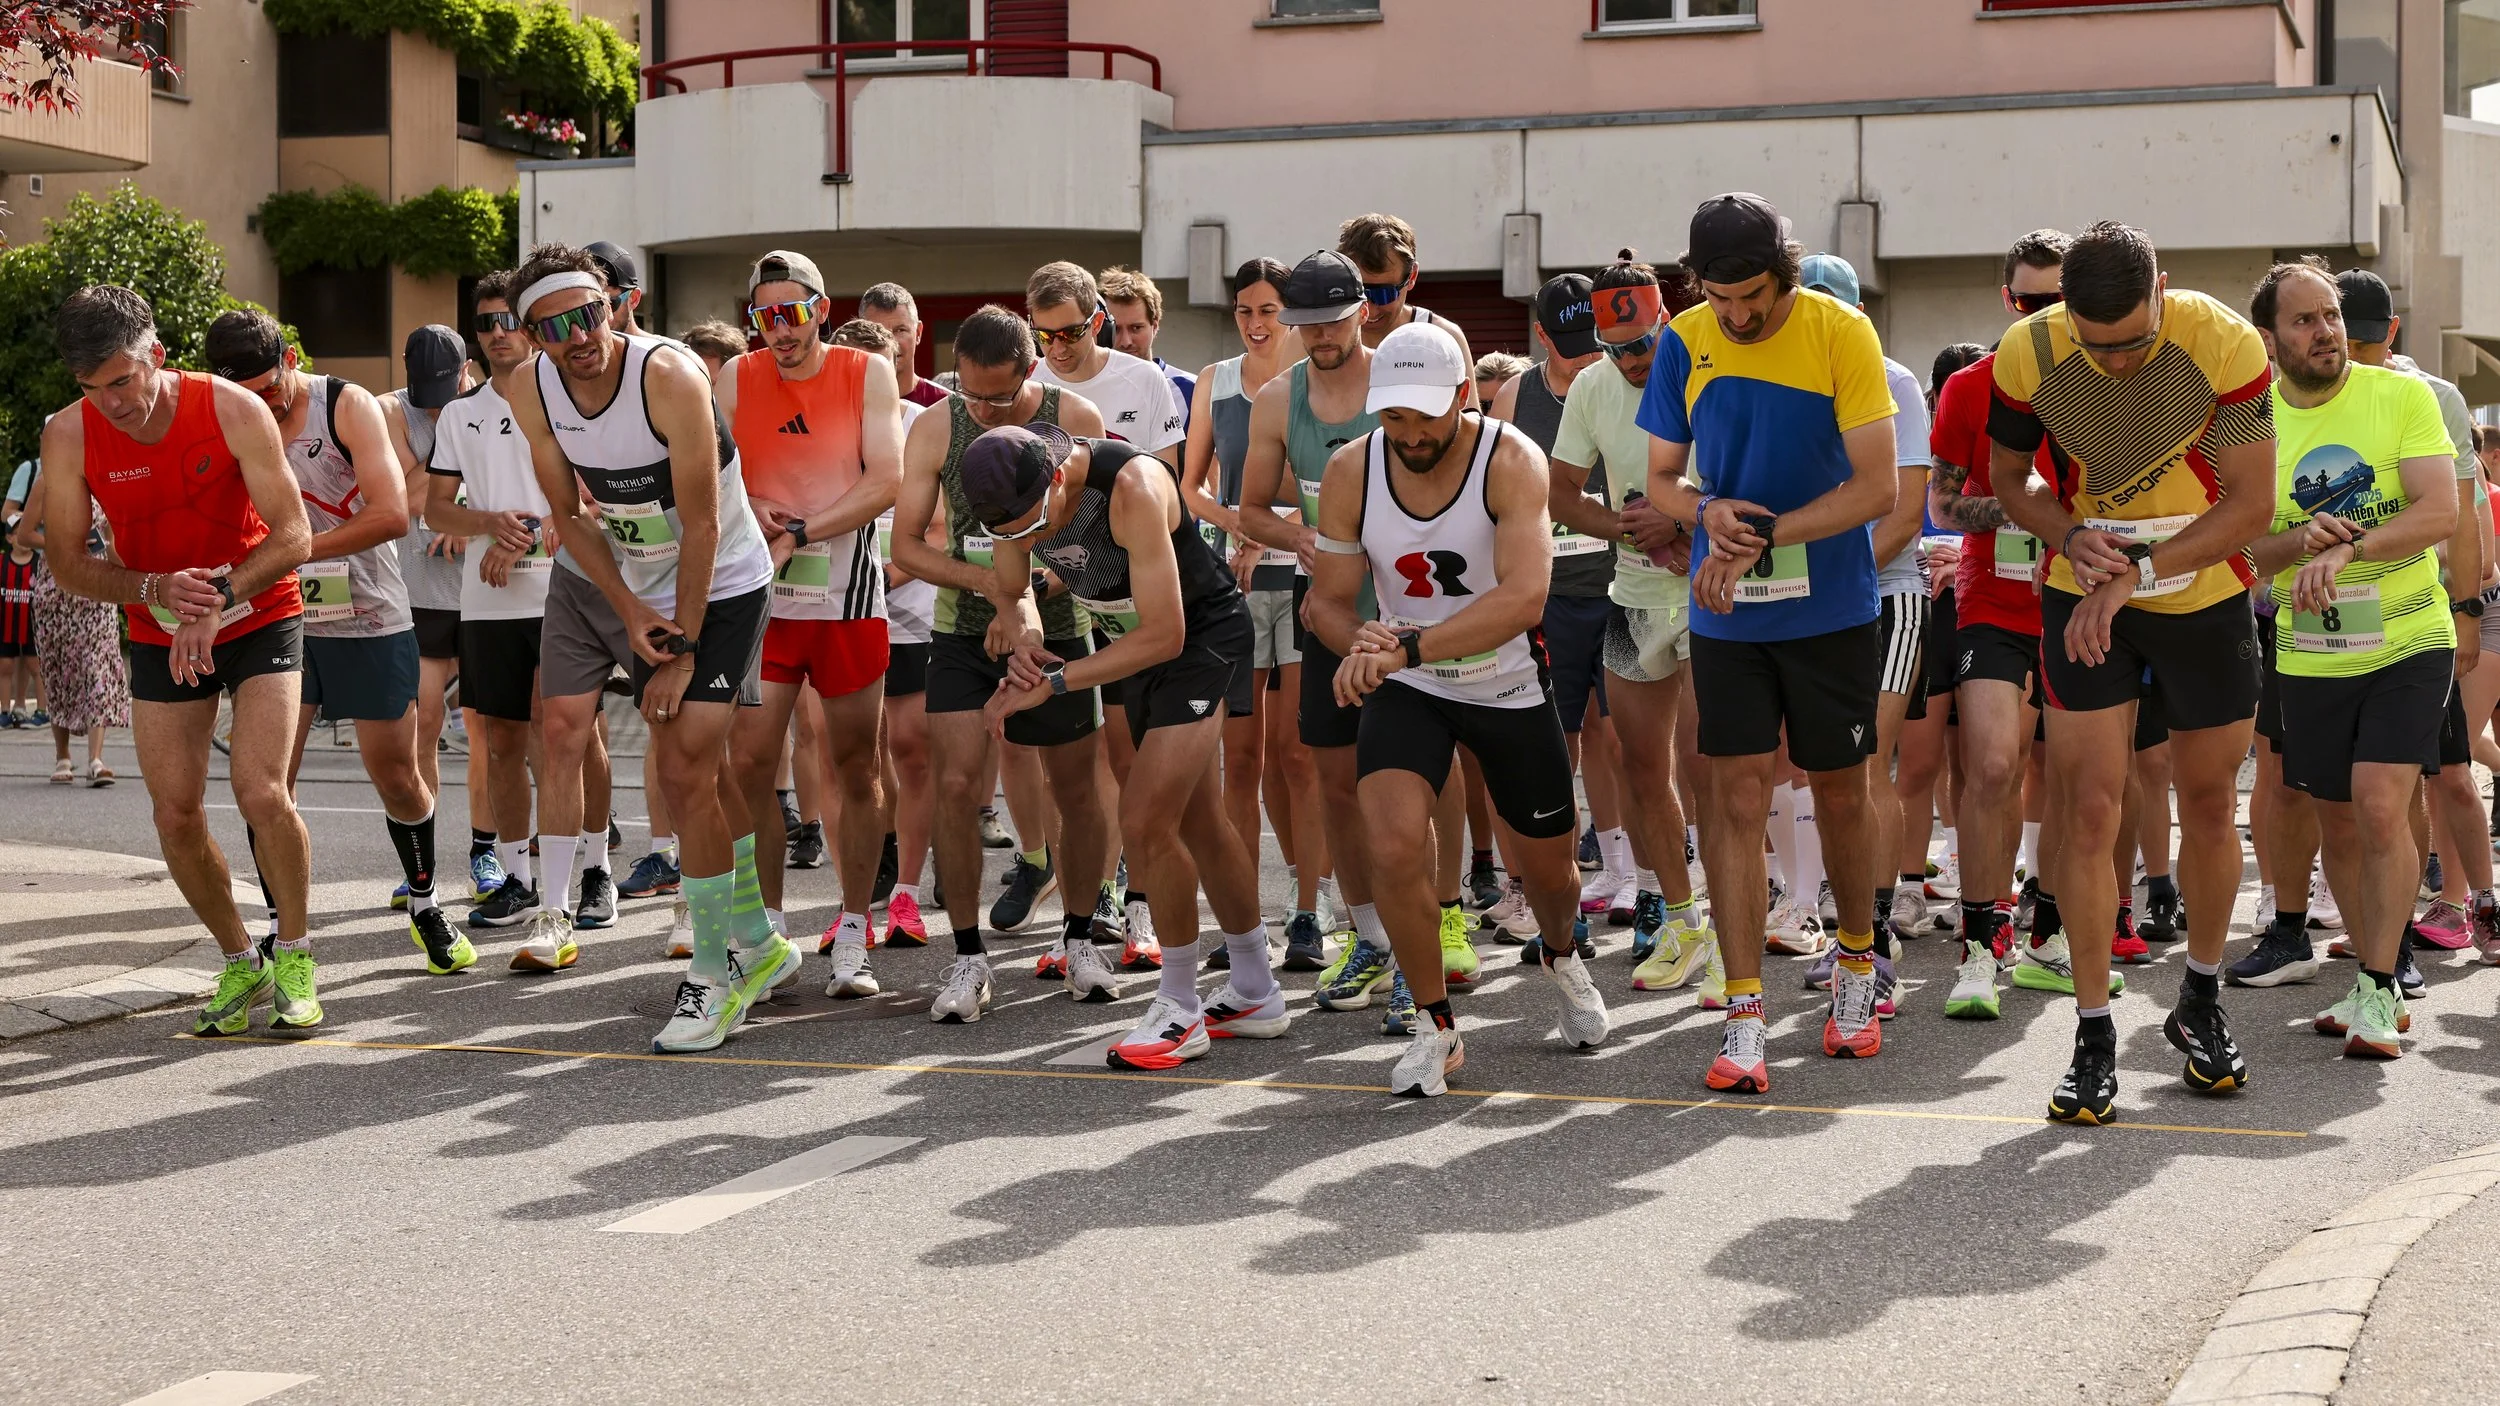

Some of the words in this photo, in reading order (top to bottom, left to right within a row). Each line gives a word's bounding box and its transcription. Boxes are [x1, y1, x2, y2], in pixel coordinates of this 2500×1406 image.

[1559, 301, 1594, 324] FAMIL
[1394, 361, 1425, 369] KIPRUN
[1696, 362, 1713, 370] erima
[499, 417, 512, 435] 2
[108, 466, 151, 479] BAYARD
[606, 475, 655, 489] TRIATHLON
[2353, 488, 2383, 506] 2025
[2376, 498, 2400, 517] (VS)
[608, 518, 645, 544] 52
[645, 545, 678, 557] RAIFFEISEN
[2157, 576, 2194, 588] RAIFFEISEN
[795, 590, 826, 598] RAIFFEISEN
[1770, 584, 1807, 595] RAIFFEISEN
[2338, 587, 2370, 598] lonzalauf
[221, 605, 249, 622] AIFFEISEN
[320, 608, 351, 617] RAIFFEISEN
[2321, 606, 2342, 632] 8
[2348, 639, 2383, 647] RAIFFEISEN
[1461, 663, 1496, 677] RAIFFEISEN
[1496, 685, 1521, 699] CRAFT
